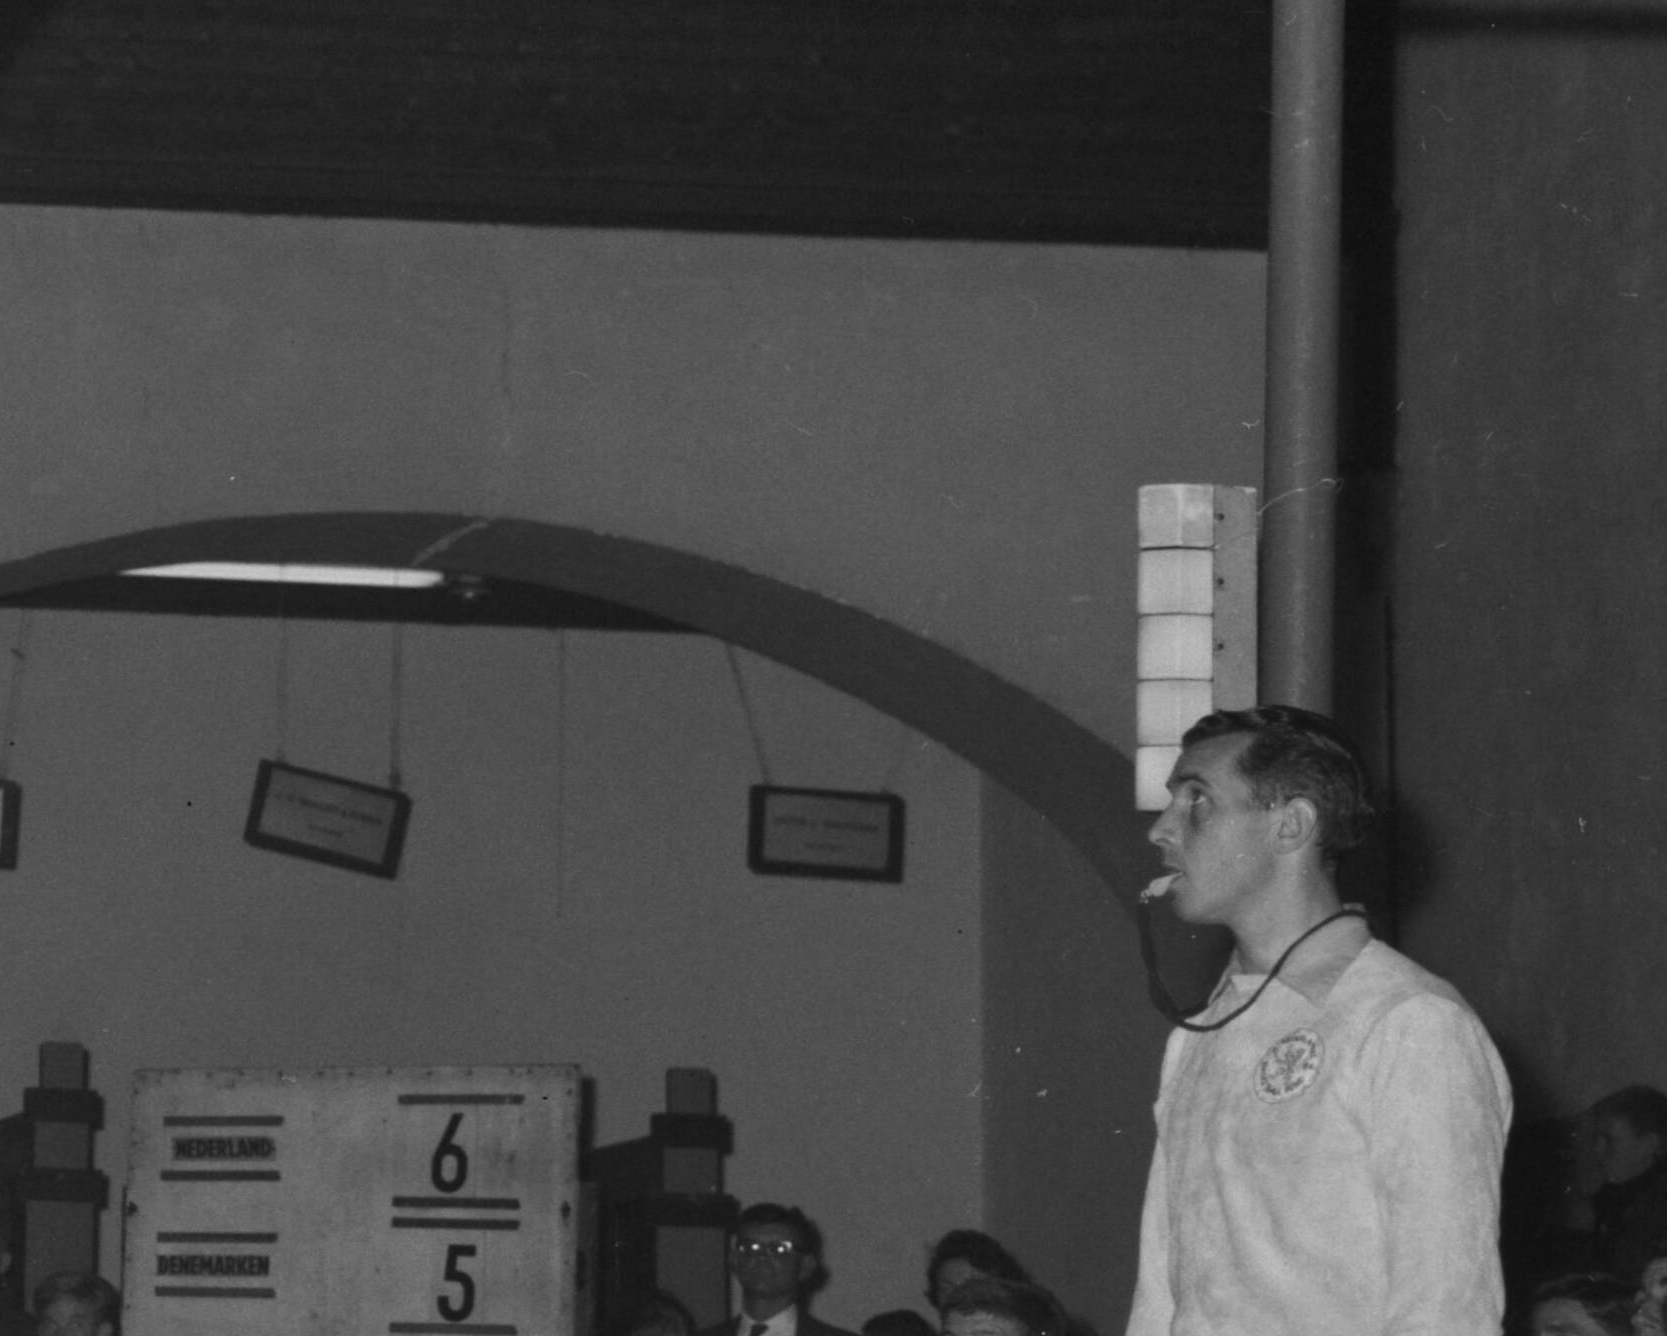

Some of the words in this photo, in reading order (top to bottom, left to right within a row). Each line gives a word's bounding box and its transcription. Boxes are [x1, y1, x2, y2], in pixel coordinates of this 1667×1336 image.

[174, 1137, 274, 1159] NEDERLAND
[431, 1113, 468, 1193] 6
[157, 1255, 269, 1276] DENEMARKEN
[437, 1244, 476, 1322] 5
